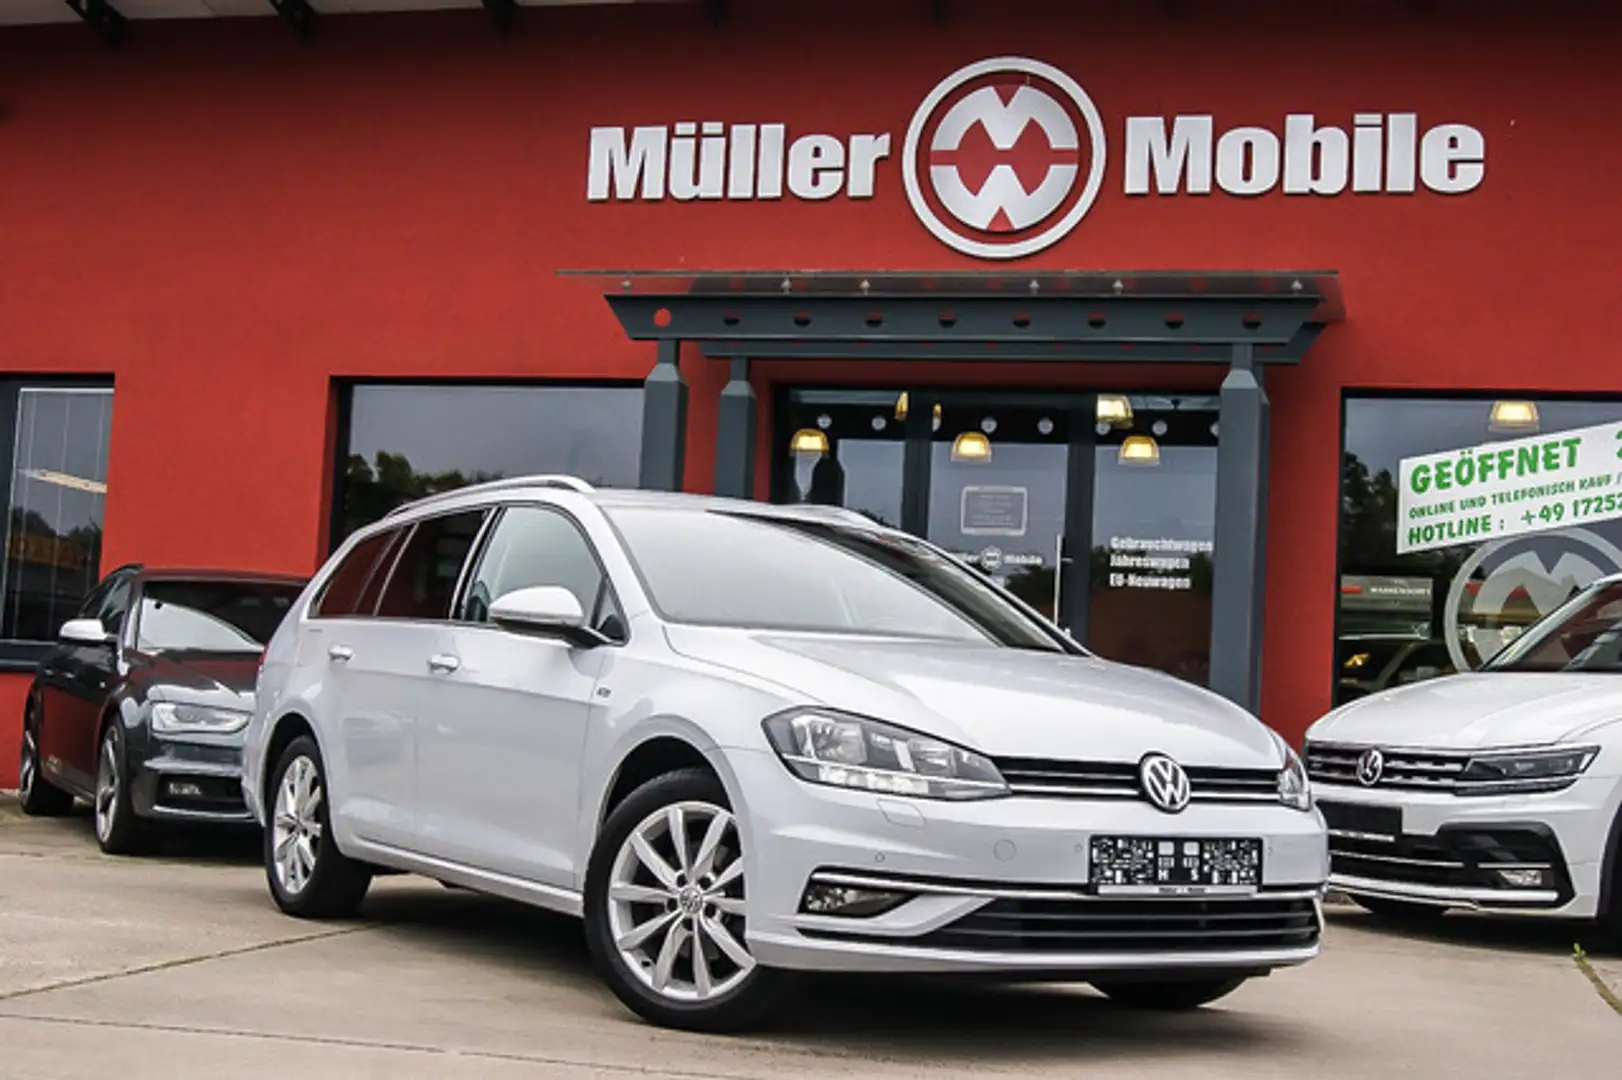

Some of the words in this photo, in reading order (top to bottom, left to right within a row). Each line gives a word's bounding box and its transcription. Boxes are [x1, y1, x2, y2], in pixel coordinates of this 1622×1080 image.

[588, 121, 891, 200] Müller
[1124, 113, 1485, 195] Mobile
[1410, 437, 1582, 494] GEÖFFNET
[1408, 500, 1455, 519] ONLINE
[1459, 496, 1486, 511] UND
[1492, 481, 1575, 505] TELEFONISCH
[1579, 474, 1612, 490] KAUF
[1110, 537, 1213, 553] Gebrauchtwagen
[1408, 514, 1492, 546] HOTLINE
[1521, 502, 1565, 525] +49
[1109, 573, 1192, 589] EU-Neuwagen
[1110, 554, 1190, 573] Jahreswagen
